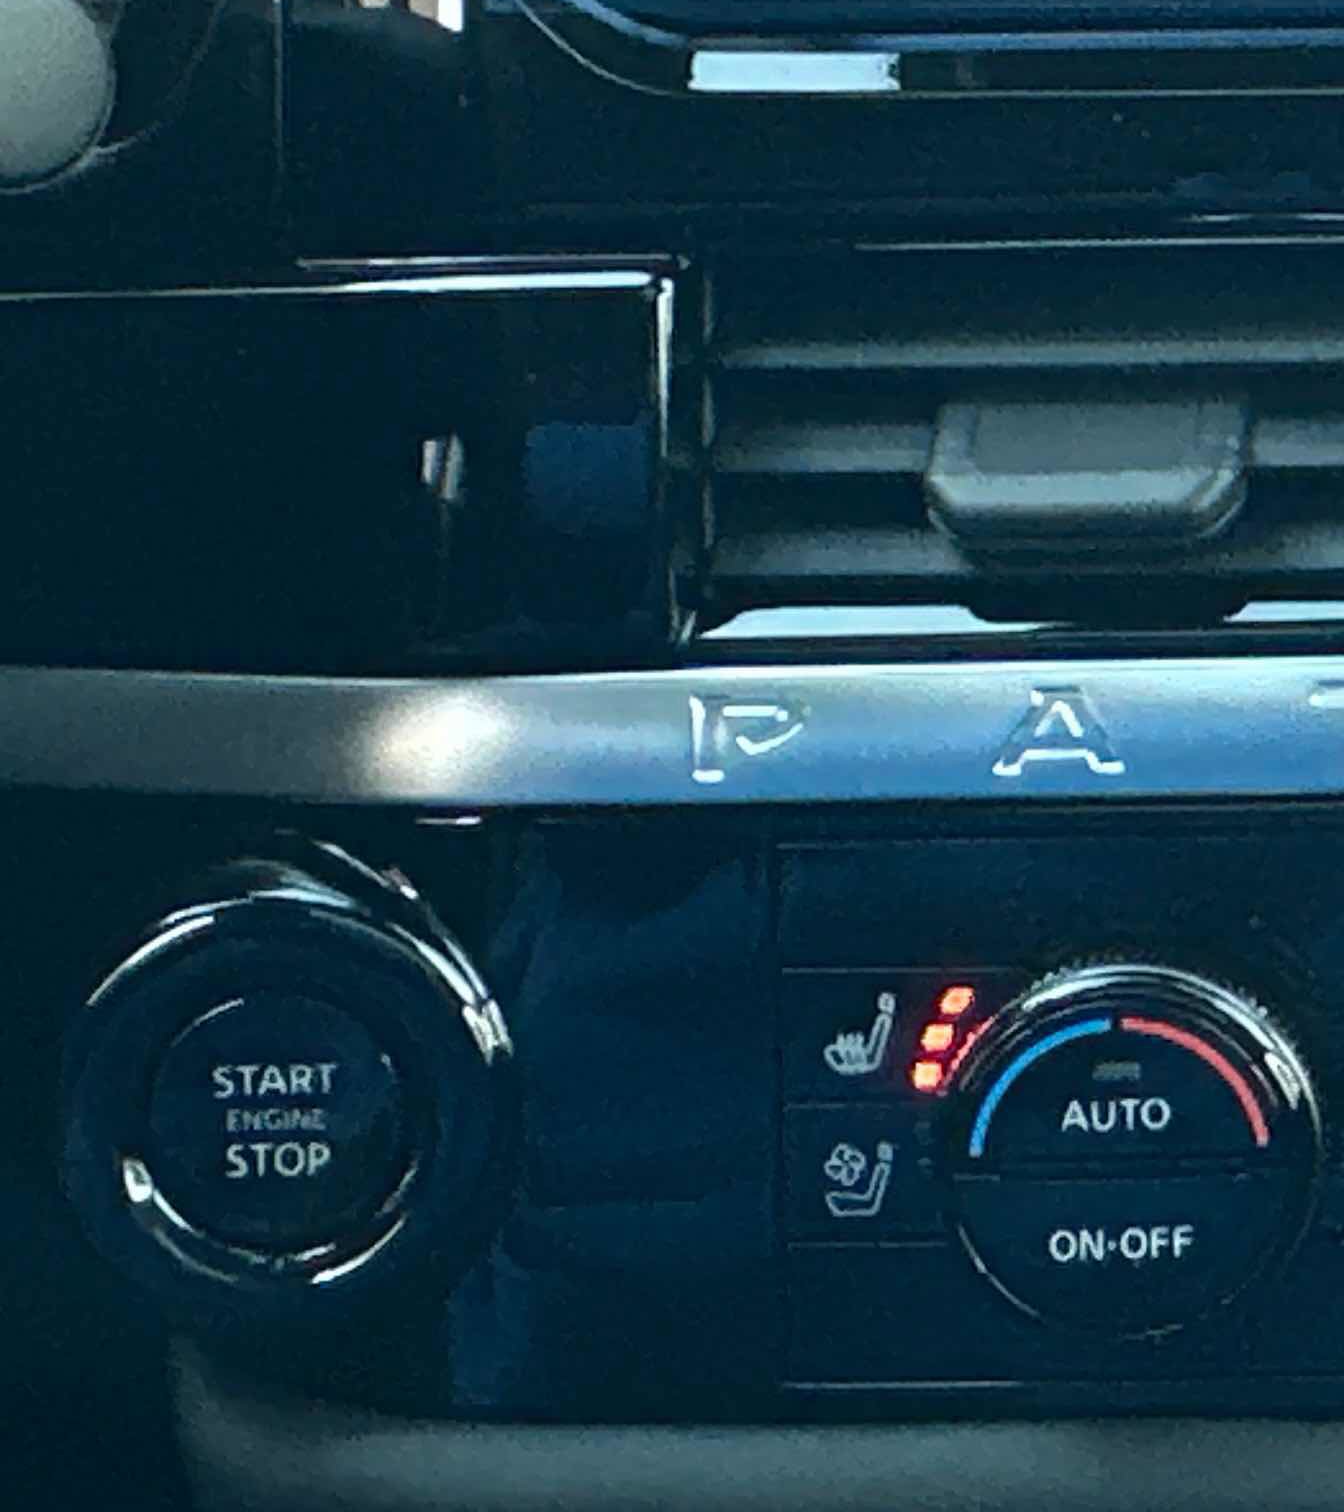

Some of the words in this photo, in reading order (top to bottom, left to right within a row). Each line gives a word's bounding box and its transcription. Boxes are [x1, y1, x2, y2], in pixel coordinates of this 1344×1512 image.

[212, 1063, 338, 1099] START
[227, 1108, 326, 1132] ENGINE
[1061, 1098, 1170, 1133] AUTO
[225, 1142, 331, 1178] STOP
